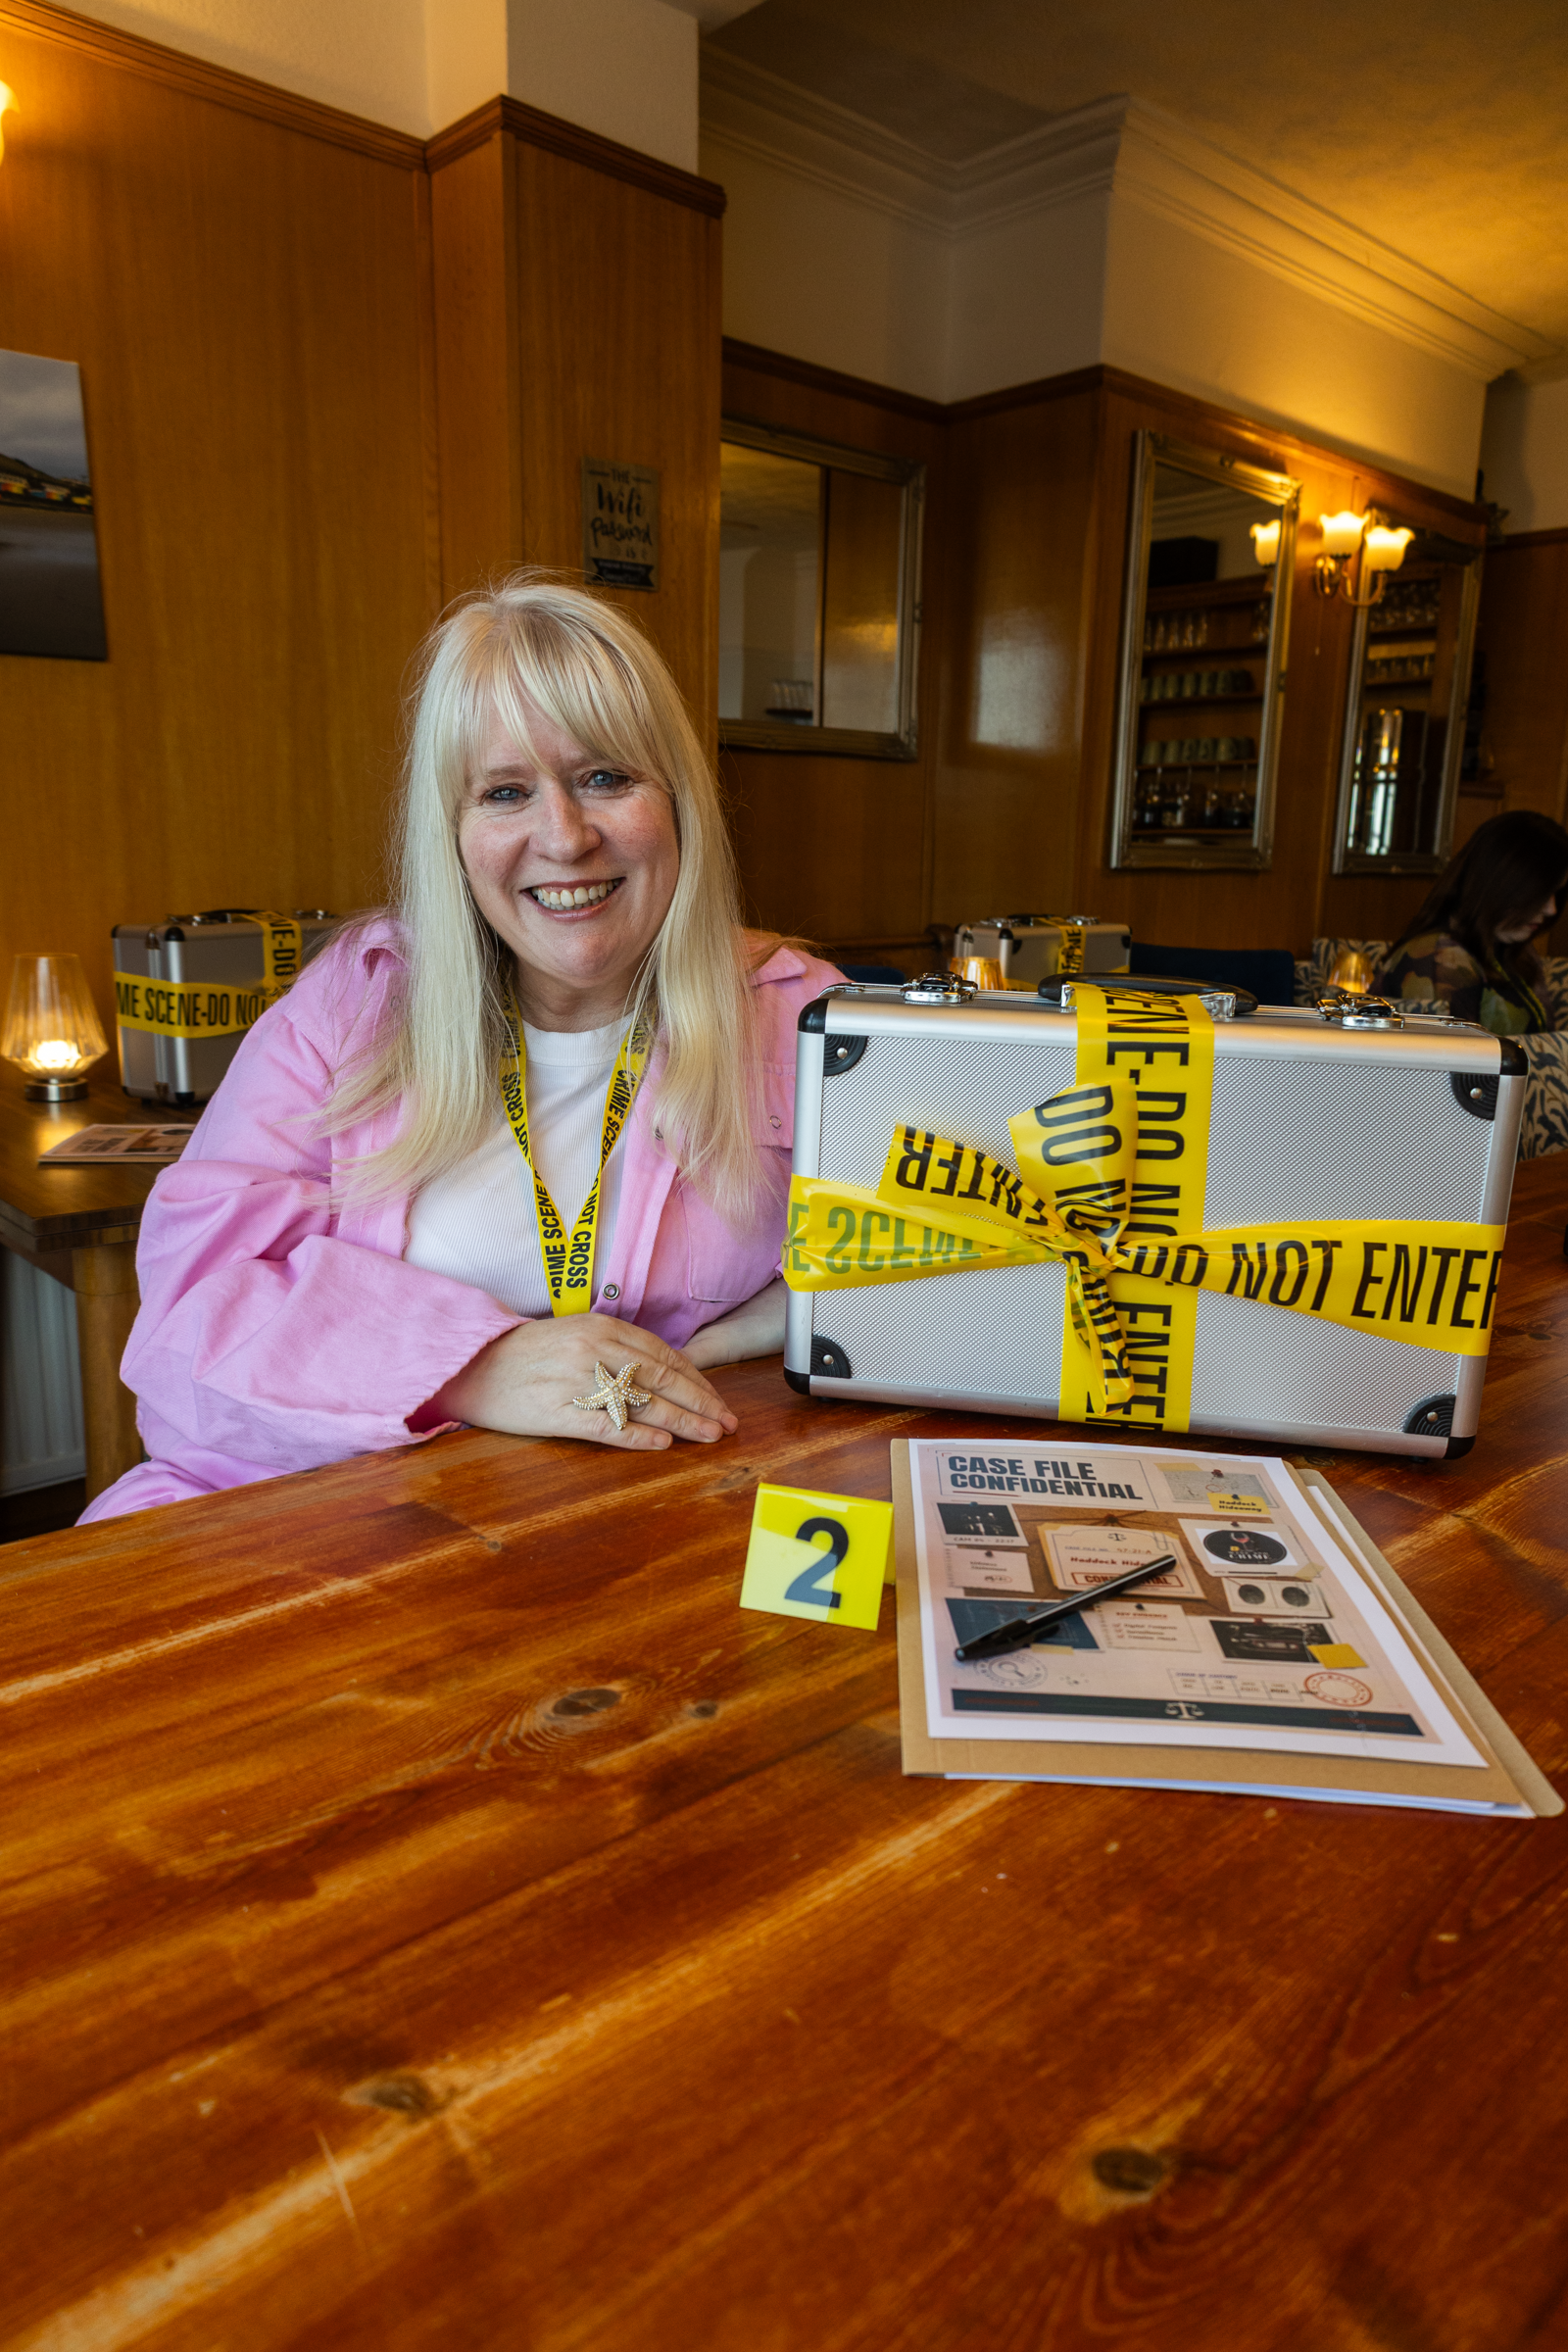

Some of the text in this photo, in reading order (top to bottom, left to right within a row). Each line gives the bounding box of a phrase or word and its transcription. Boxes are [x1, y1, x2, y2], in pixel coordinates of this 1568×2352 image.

[235, 994, 266, 1025] NO
[502, 1070, 523, 1122] CROSS
[607, 1069, 637, 1120] CRIME
[1033, 1085, 1123, 1166] DO
[536, 1183, 563, 1240] SCENE
[578, 1193, 597, 1225] NOT
[565, 1231, 592, 1289] CROSS
[1225, 1239, 1343, 1310] NOT
[949, 1455, 1097, 1481] CASE FILE
[951, 1473, 1144, 1500] CONFIDENTIAL
[784, 1516, 850, 1609] 2
